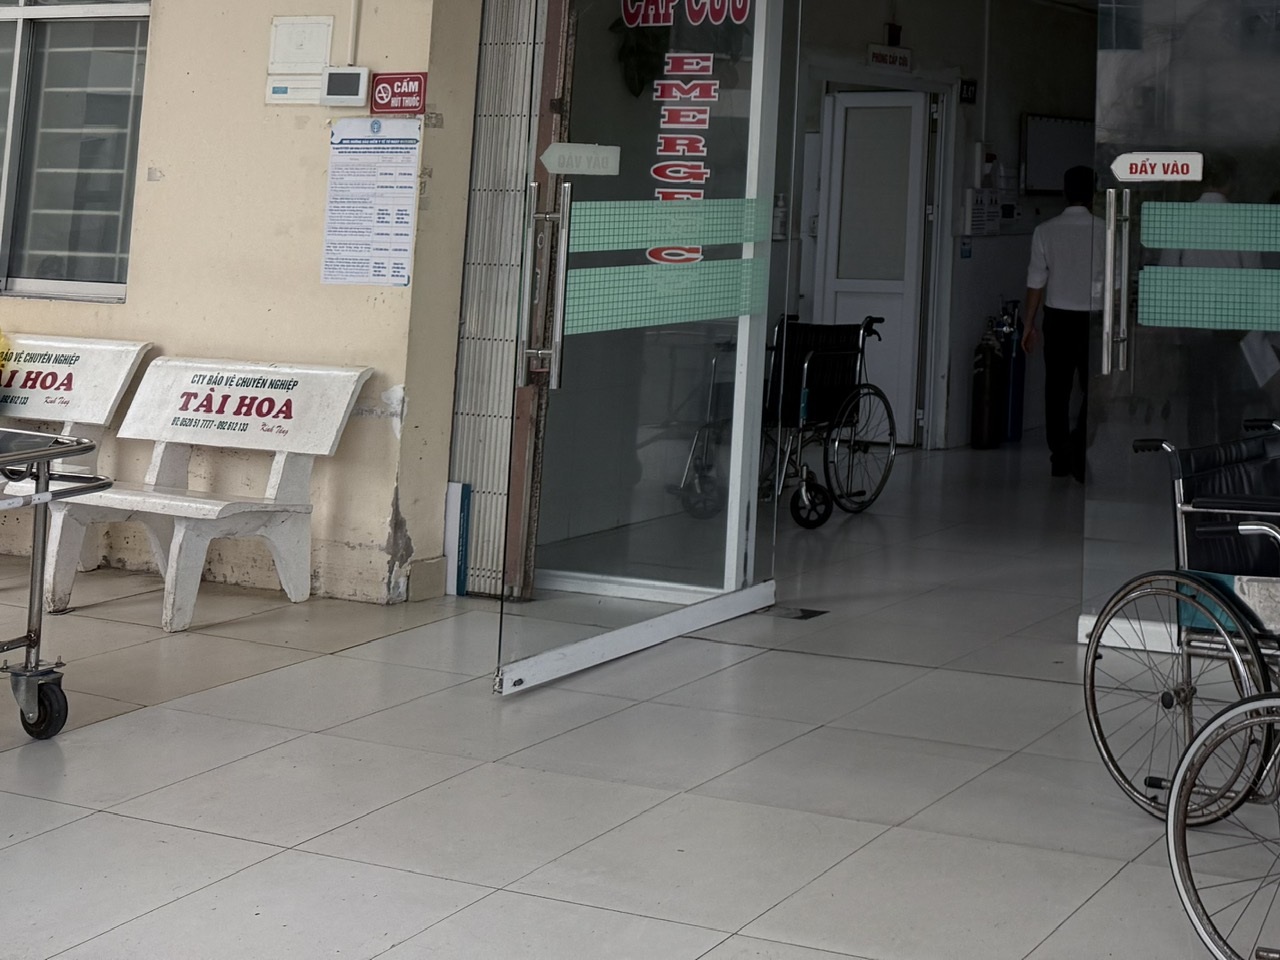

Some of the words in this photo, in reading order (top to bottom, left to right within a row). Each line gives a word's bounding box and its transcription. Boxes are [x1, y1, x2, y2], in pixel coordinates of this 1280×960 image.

[394, 78, 418, 92] CẤM
[1129, 158, 1157, 175] ĐẨY
[1162, 160, 1189, 175] VÀO
[24, 351, 53, 364] CHUYÊN
[52, 353, 80, 367] NGHIỆP
[20, 371, 73, 391] HOA
[191, 374, 207, 384] CTY
[235, 376, 267, 389] CHUYÊN
[267, 378, 298, 392] NGHIỆP
[178, 387, 231, 414] TÀI
[233, 396, 293, 419] HOA
